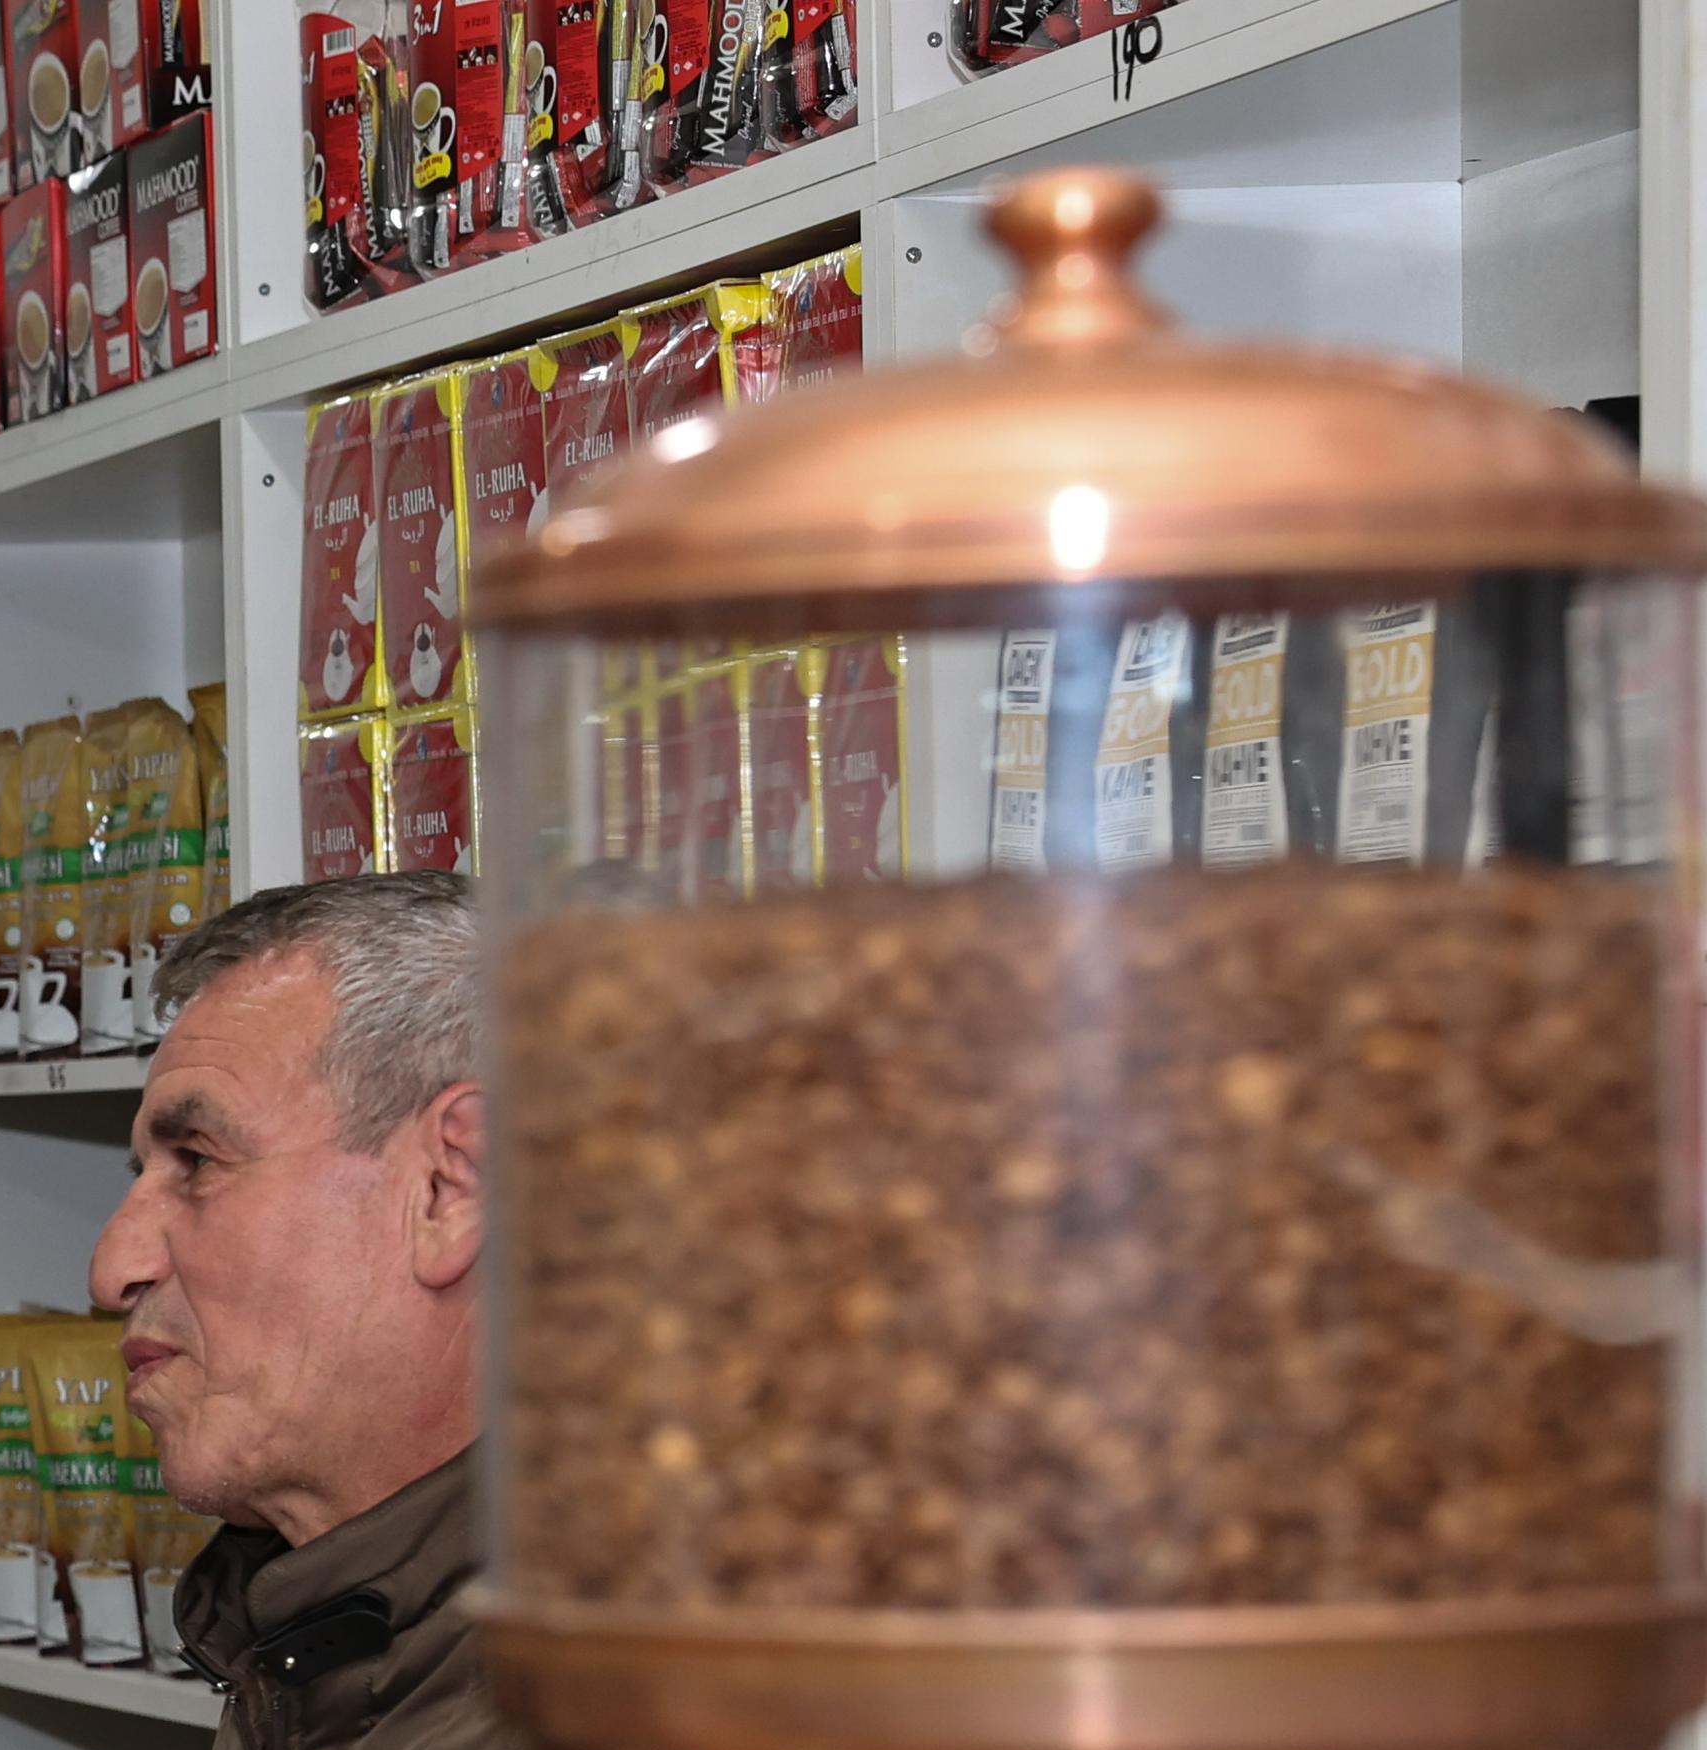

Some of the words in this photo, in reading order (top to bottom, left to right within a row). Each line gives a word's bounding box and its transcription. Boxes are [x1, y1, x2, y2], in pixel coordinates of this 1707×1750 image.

[1111, 15, 1163, 102] 190
[172, 74, 212, 105] M
[736, 100, 754, 140] Original
[136, 158, 199, 213] MAHMOOD
[175, 189, 199, 214] COFFEE
[565, 430, 614, 467] EL-RUHA
[475, 462, 526, 500] EL-RUHA
[314, 494, 360, 530] EL-RUHA
[388, 485, 436, 521] EL-RUHA
[312, 826, 356, 856] EL-RUHA
[403, 811, 448, 839] EL-RUHA
